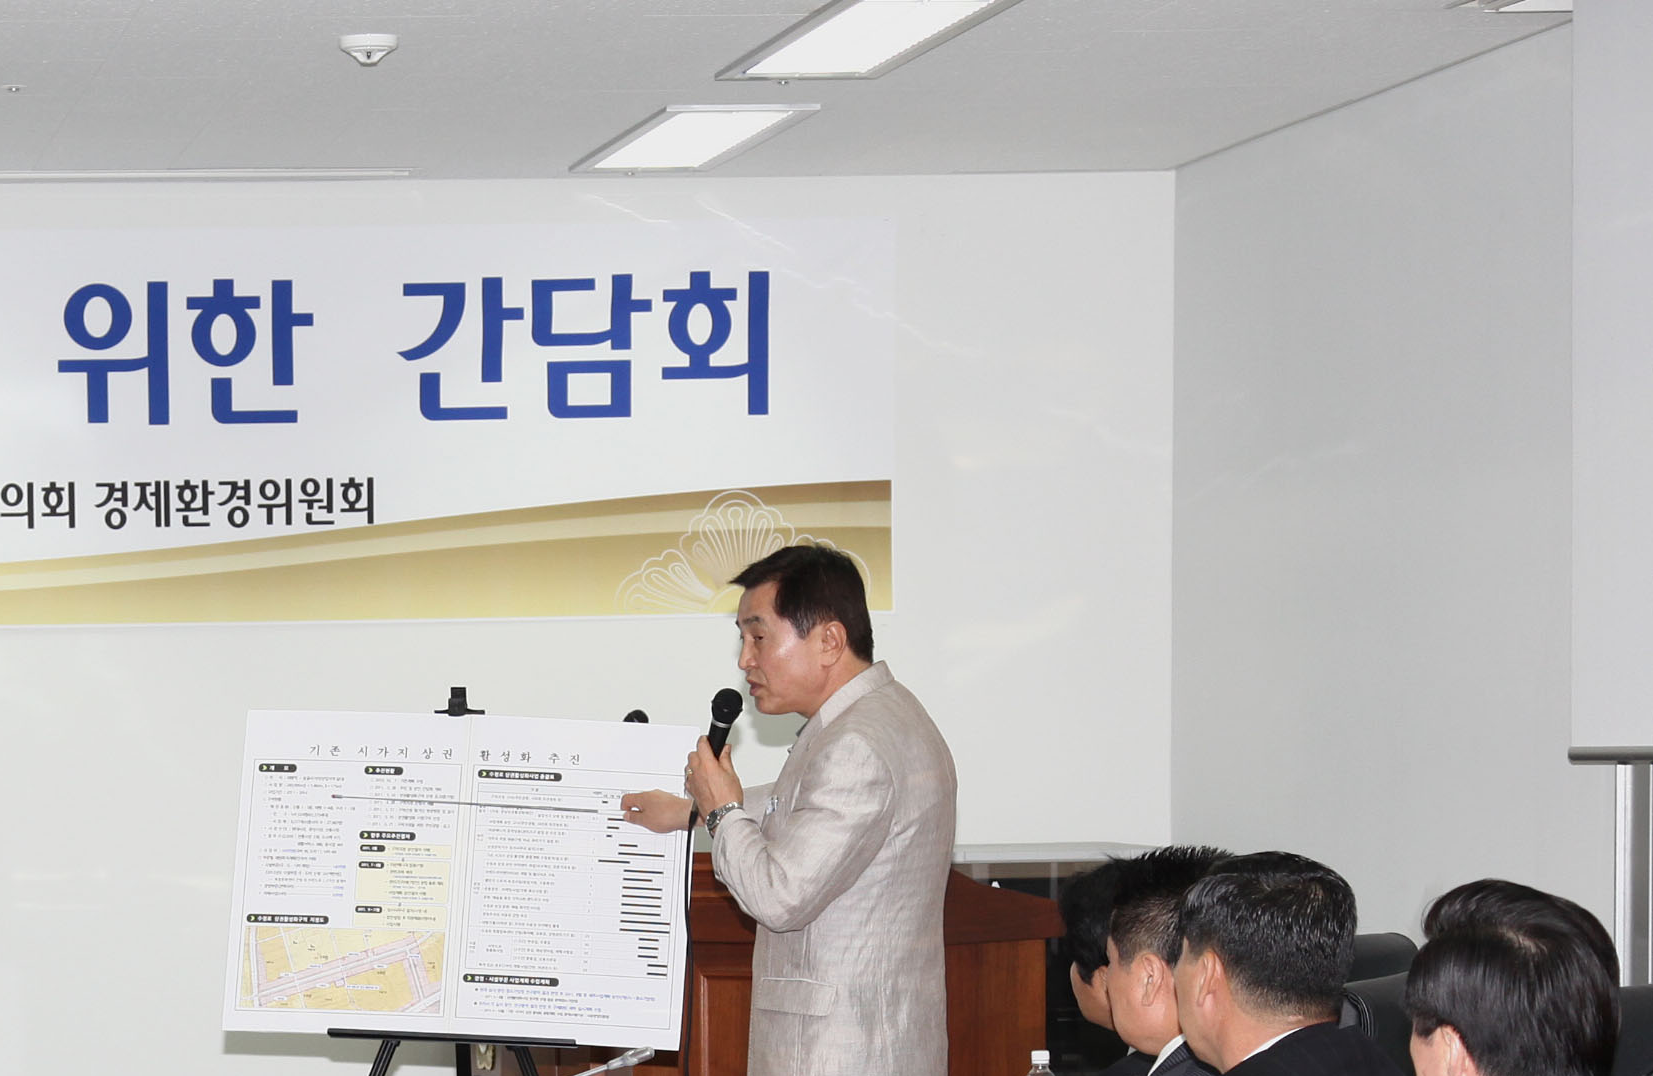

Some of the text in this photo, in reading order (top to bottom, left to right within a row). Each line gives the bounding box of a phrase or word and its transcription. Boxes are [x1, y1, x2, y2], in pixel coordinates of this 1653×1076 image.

[58, 279, 314, 425] 위한
[399, 271, 770, 421] 간담회
[95, 477, 375, 530] 경제환경위원회
